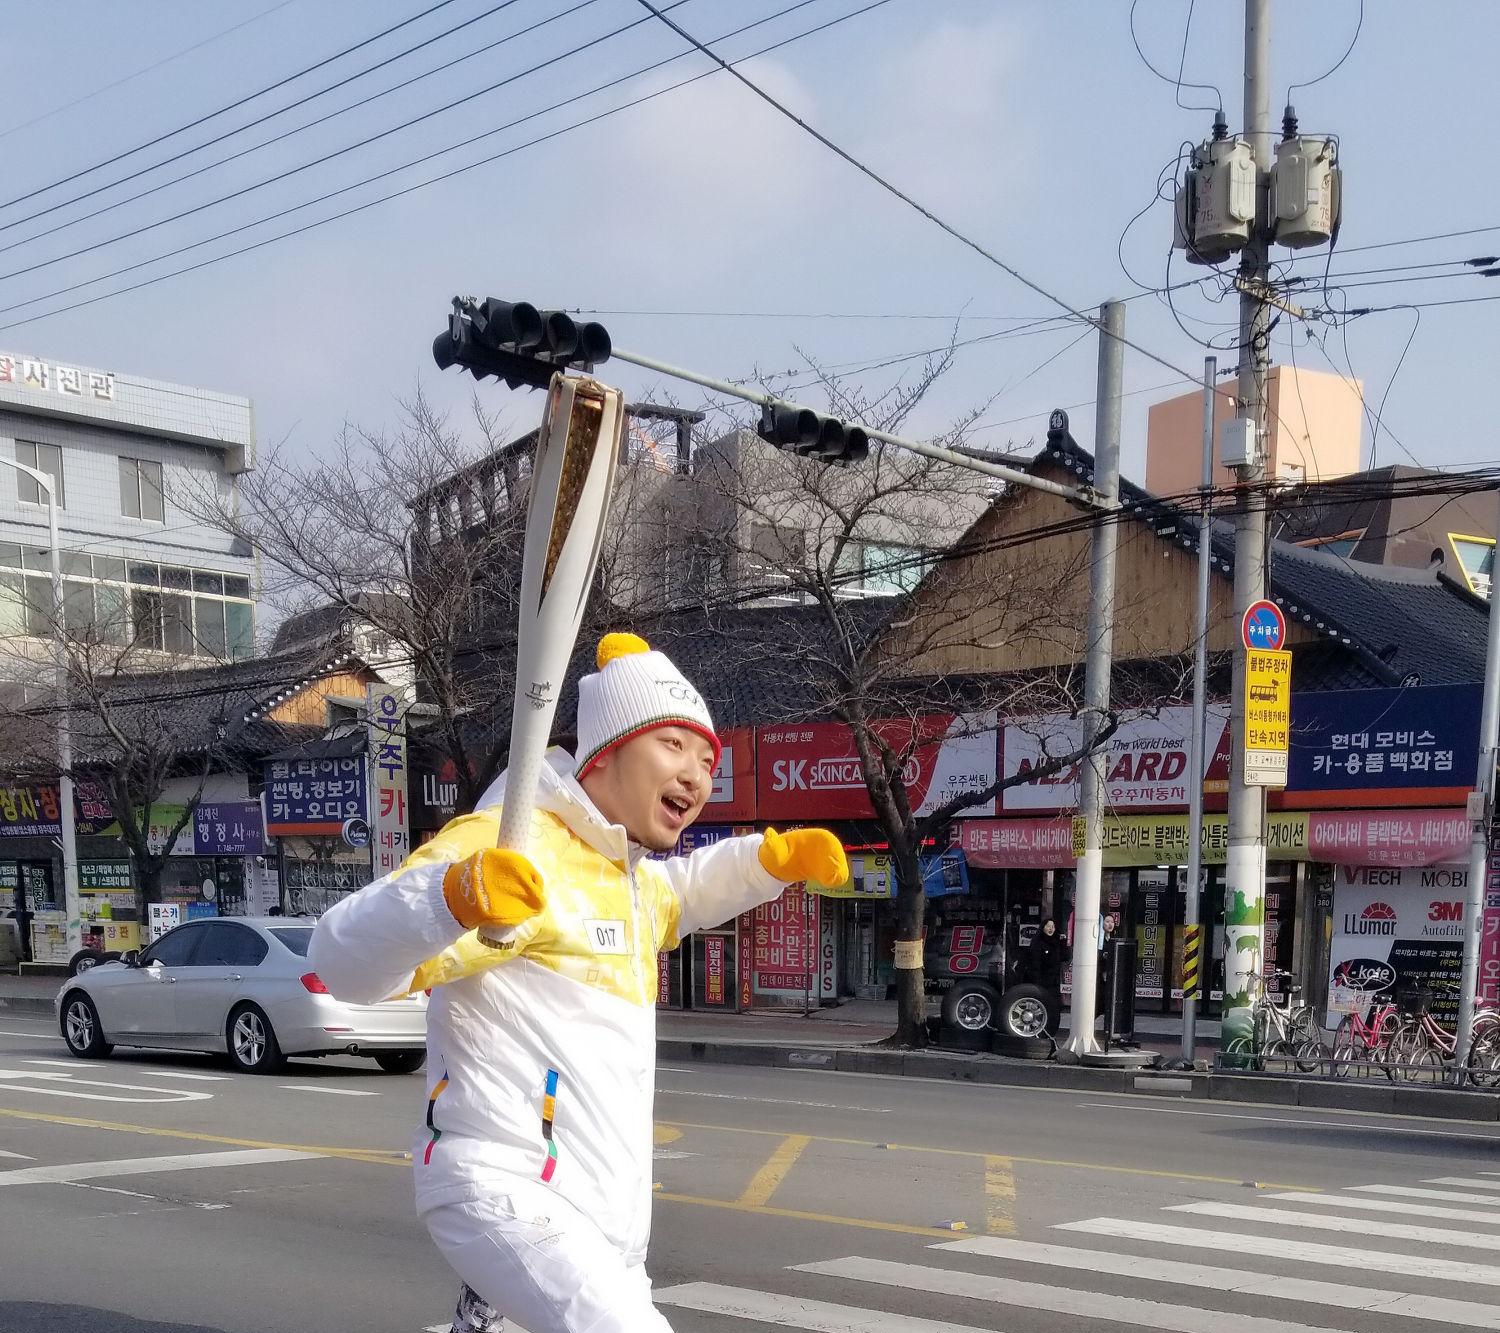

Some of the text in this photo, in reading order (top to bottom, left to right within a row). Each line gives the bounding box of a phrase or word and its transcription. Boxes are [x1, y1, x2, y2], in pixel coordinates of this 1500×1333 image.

[1250, 657, 1288, 674] 불법주정차
[1112, 739, 1130, 751] The
[1162, 737, 1185, 749] best
[1250, 729, 1286, 746] 단속지역
[1331, 730, 1436, 750] 현대 모비스
[1389, 750, 1454, 772] 백화점
[947, 774, 989, 788] 우주썬팅
[1110, 786, 1186, 801] 우주자동차
[198, 822, 245, 843] 행정사
[970, 830, 988, 851] 만도
[1032, 828, 1073, 851] 내비게이
[1101, 825, 1150, 849] 인드라이브
[1154, 825, 1190, 849] 블랙박
[1265, 822, 1304, 848] 게이션
[1314, 821, 1362, 847] 아이나비
[1420, 819, 1472, 846] 내비게이
[1421, 871, 1468, 888] MOBI
[1428, 901, 1464, 921] 3M
[770, 896, 785, 968] 이나비
[1344, 914, 1397, 936] LLumar
[596, 927, 616, 947] 017
